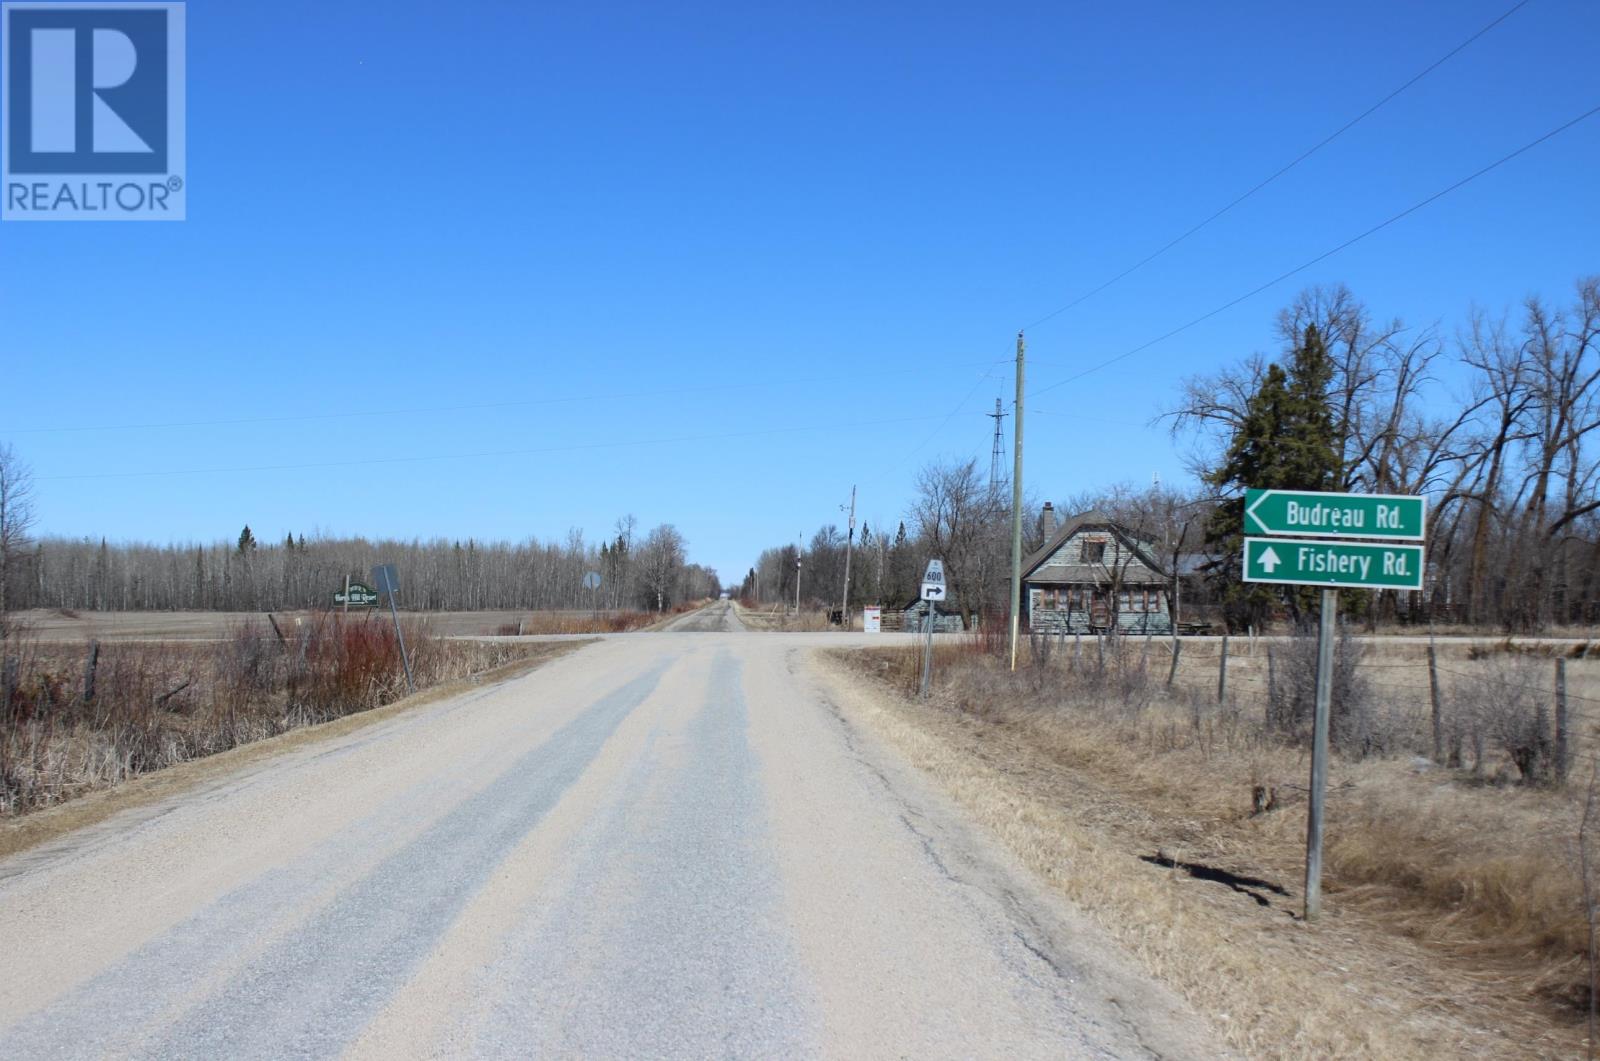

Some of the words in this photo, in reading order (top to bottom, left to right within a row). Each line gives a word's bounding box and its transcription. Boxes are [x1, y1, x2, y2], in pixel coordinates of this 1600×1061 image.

[1286, 501, 1364, 528] Budreau
[1376, 504, 1405, 528] Rd.
[927, 571, 942, 582] 600
[1298, 547, 1372, 580] Fishery
[1383, 551, 1412, 576] Rd.
